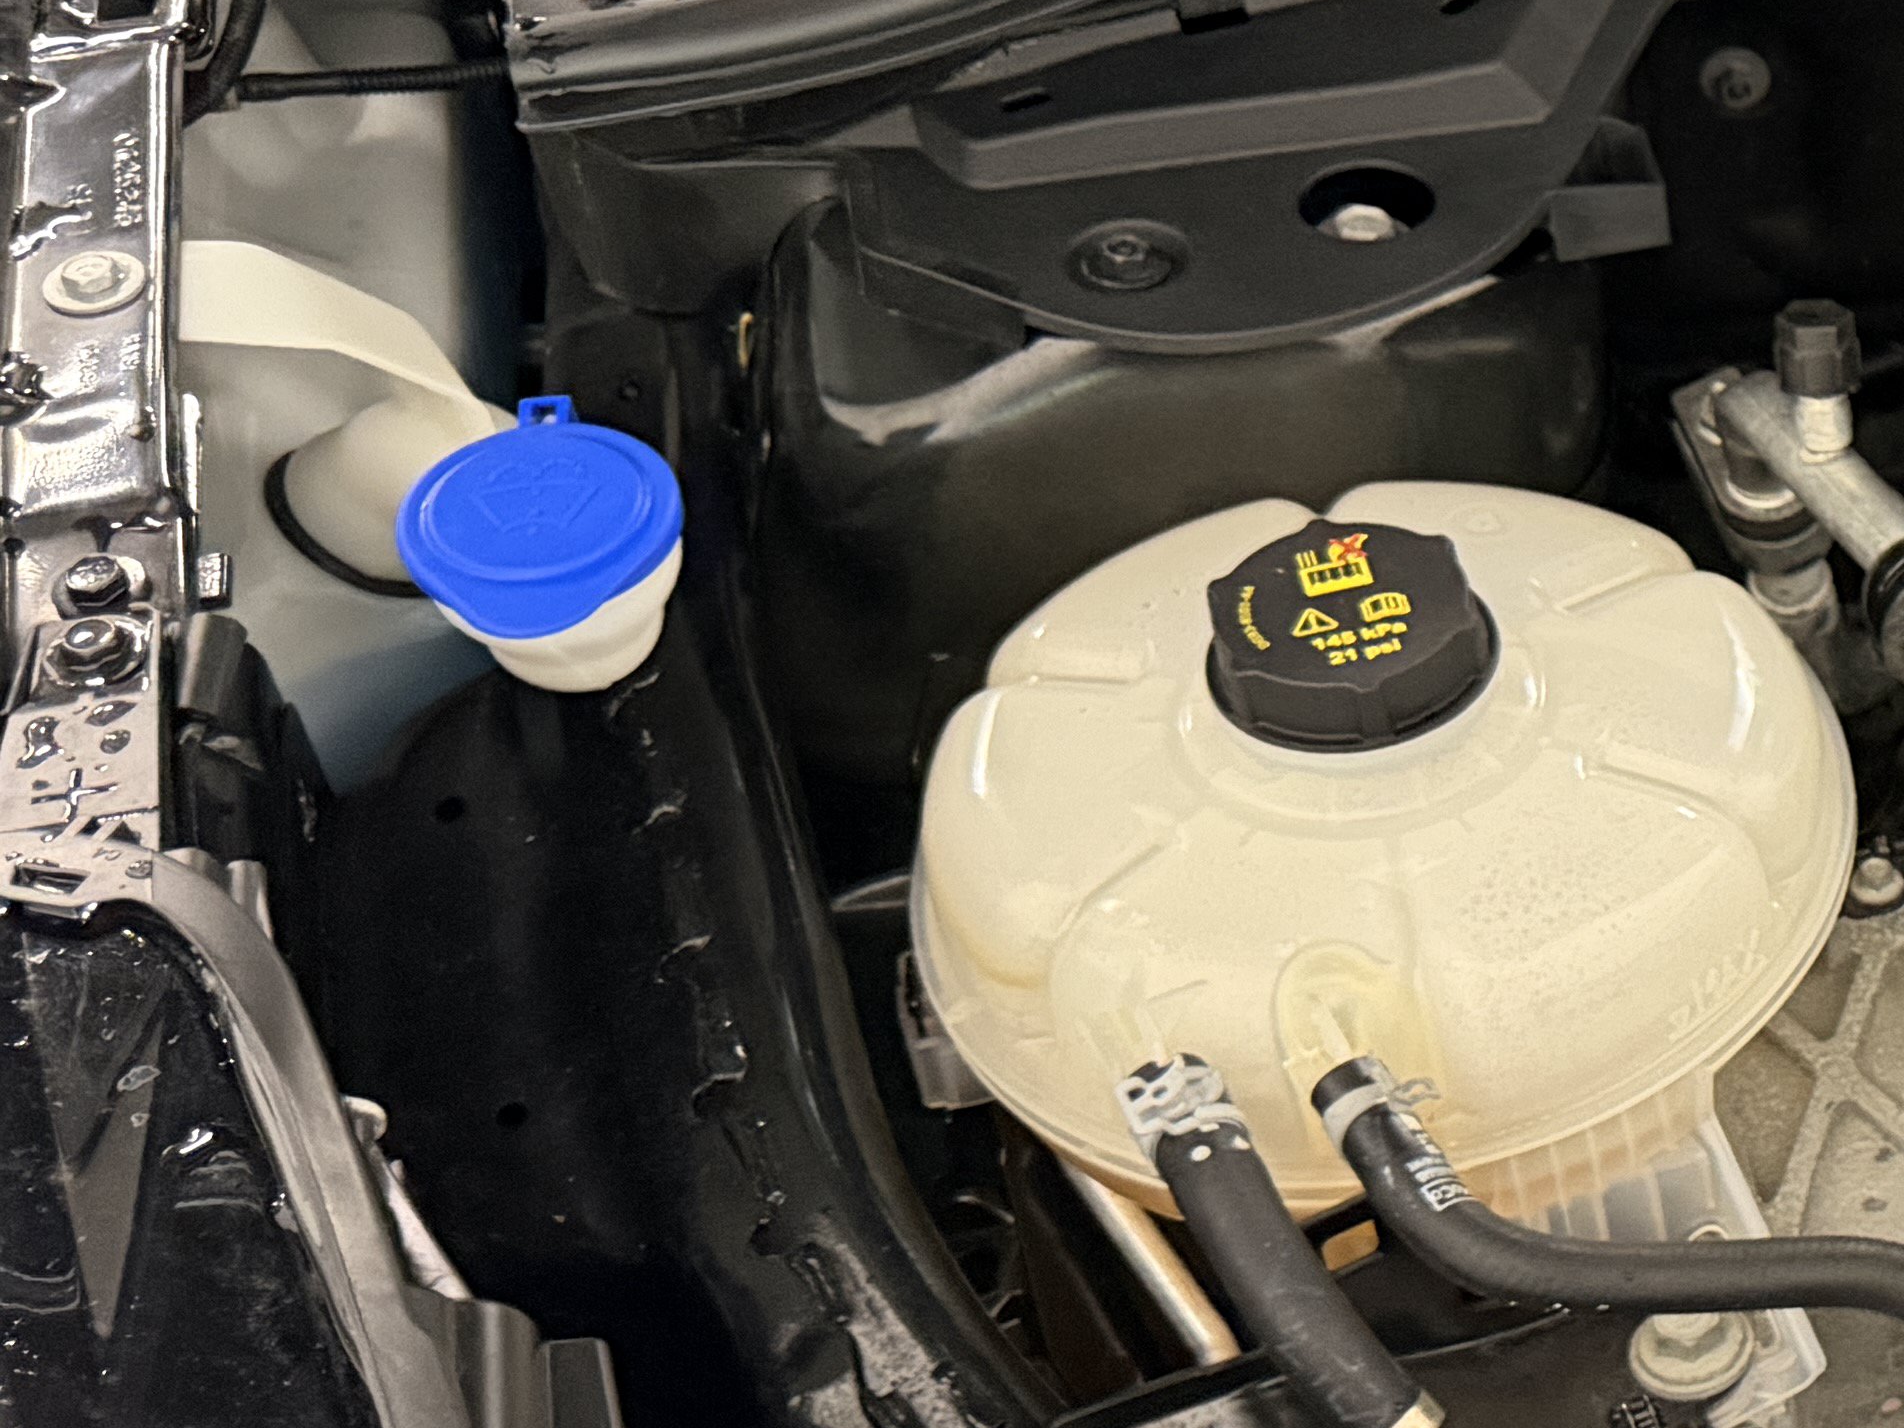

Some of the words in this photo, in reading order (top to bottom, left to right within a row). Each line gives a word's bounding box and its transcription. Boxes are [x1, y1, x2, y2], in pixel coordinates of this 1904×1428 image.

[1312, 631, 1357, 650] 145
[1360, 622, 1408, 640] kPa
[1329, 649, 1358, 666] 21
[1364, 638, 1402, 660] psi
